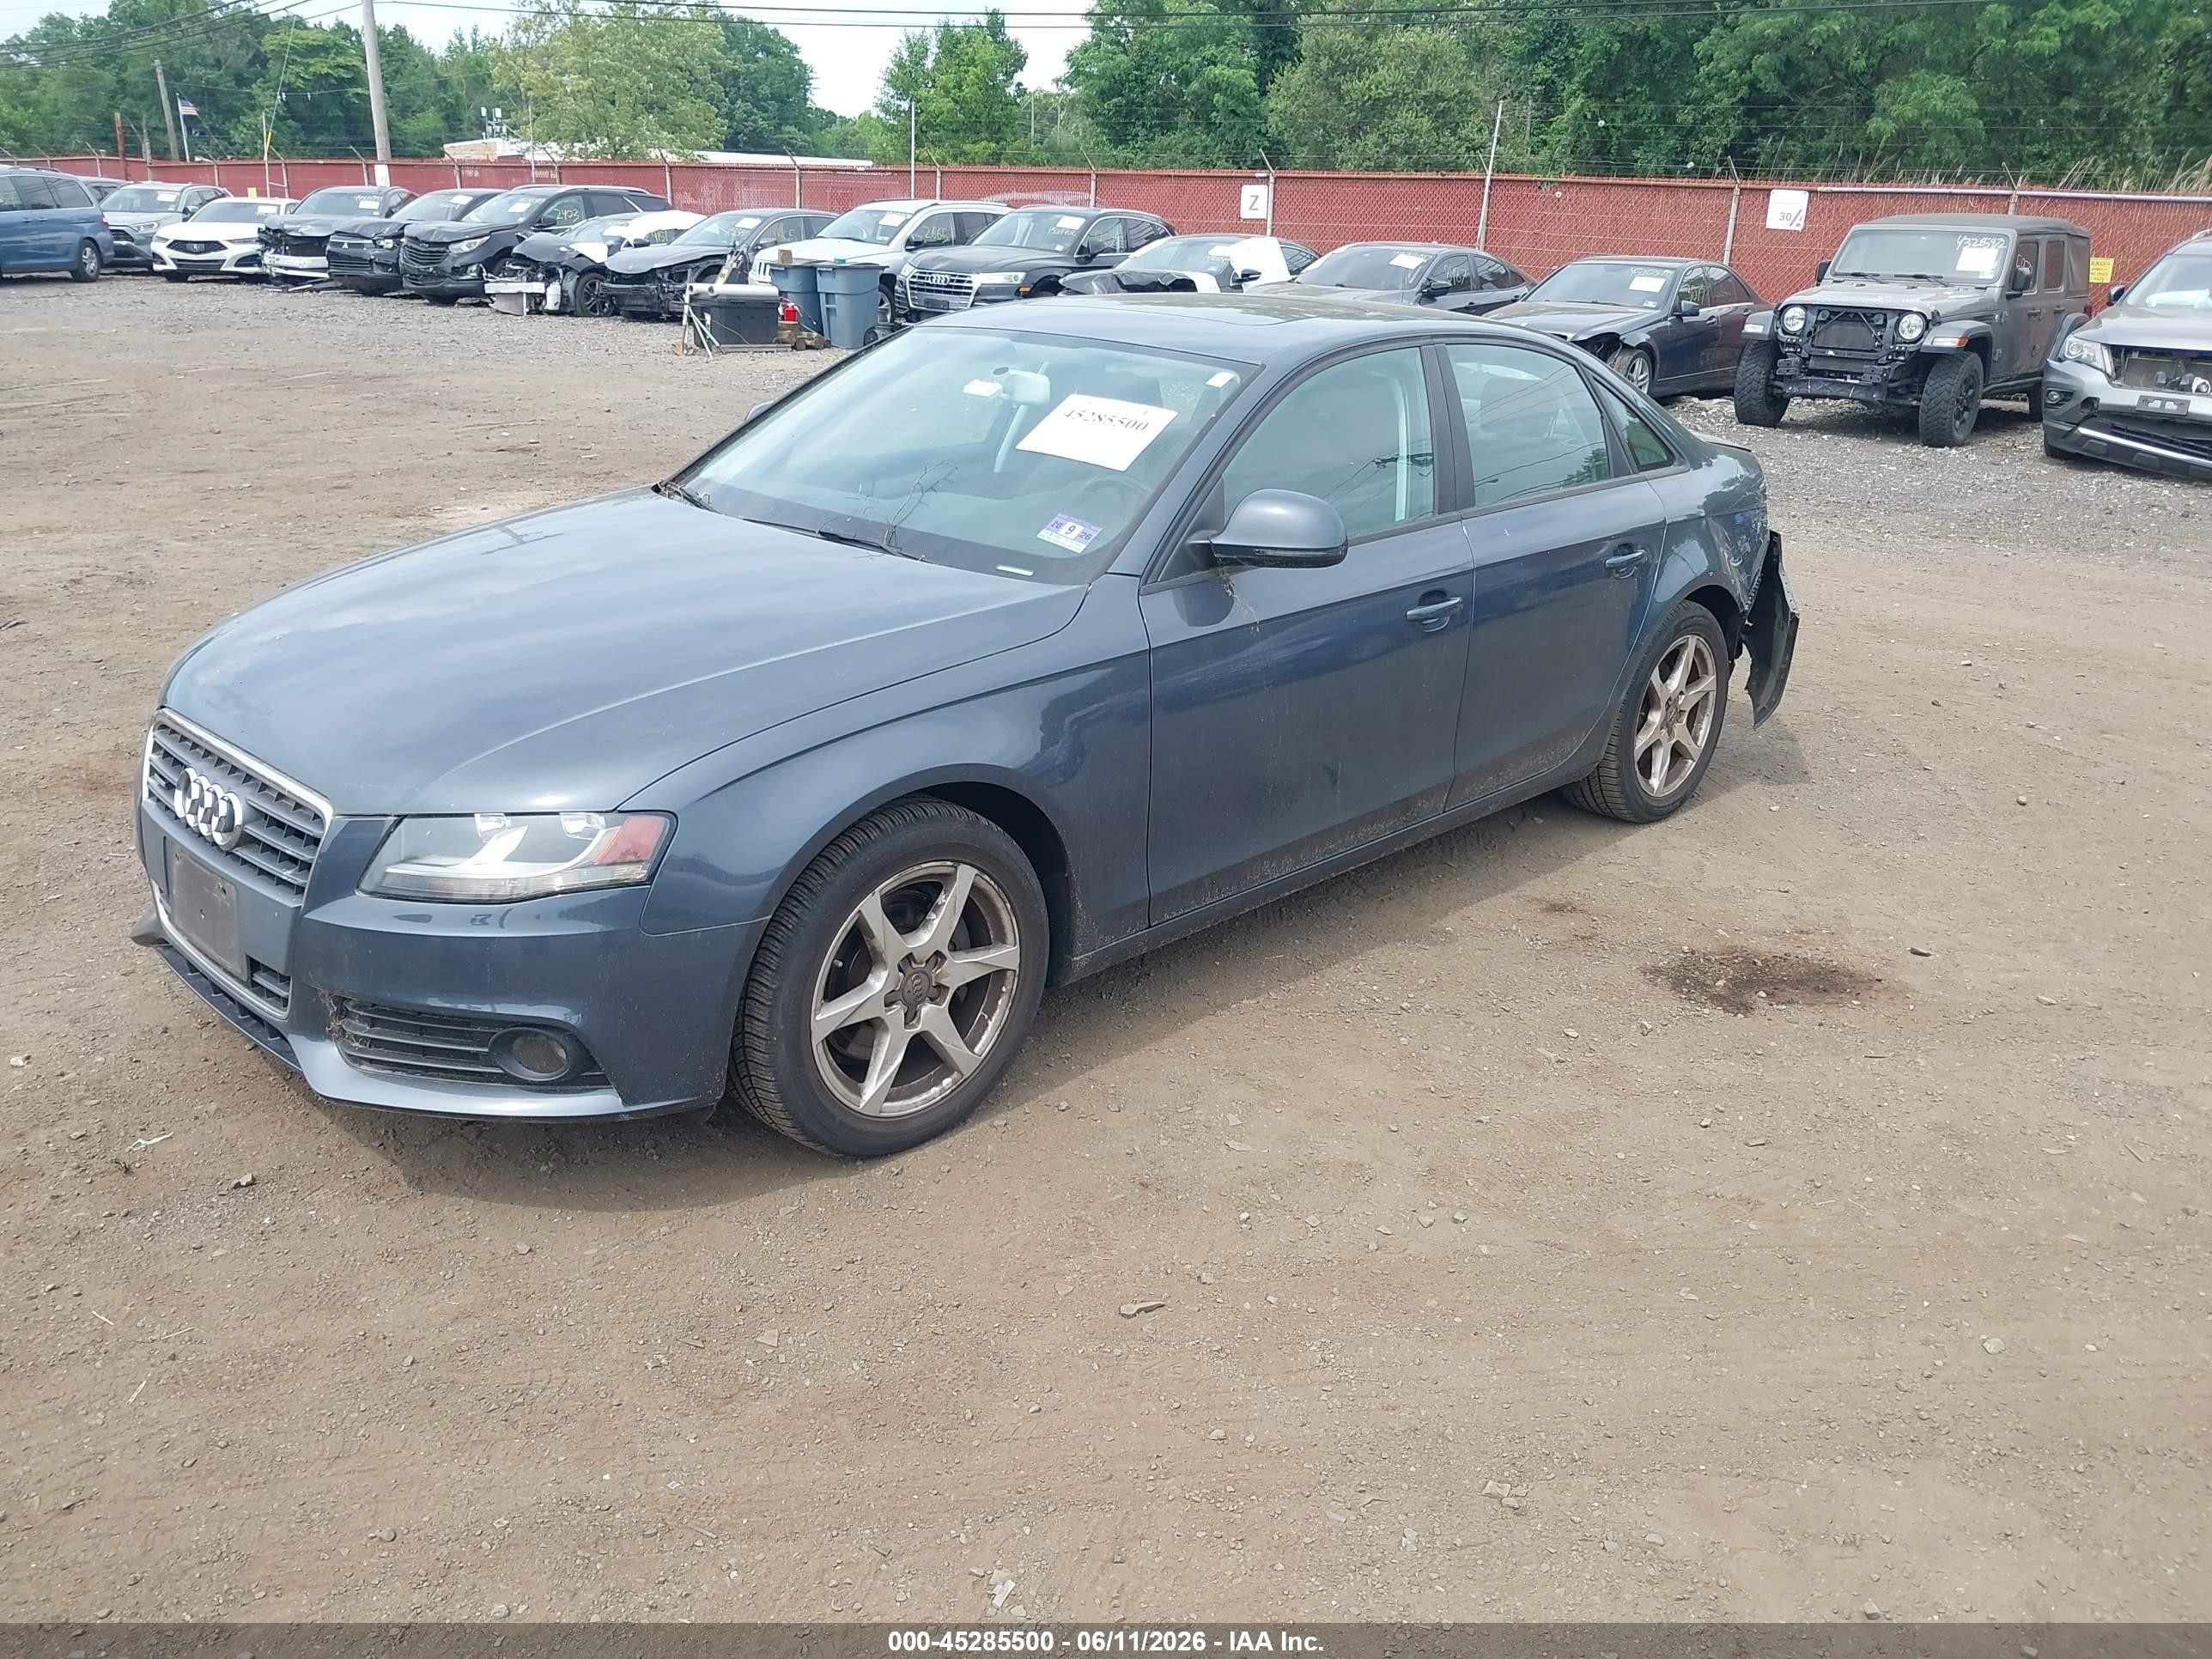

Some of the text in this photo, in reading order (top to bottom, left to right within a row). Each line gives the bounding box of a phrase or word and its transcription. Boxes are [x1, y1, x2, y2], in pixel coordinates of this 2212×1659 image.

[1249, 195, 1260, 211] Z
[1064, 409, 1149, 431] 45285500
[1051, 520, 1063, 530] 20
[1065, 525, 1077, 535] 9
[1079, 531, 1093, 541] 26
